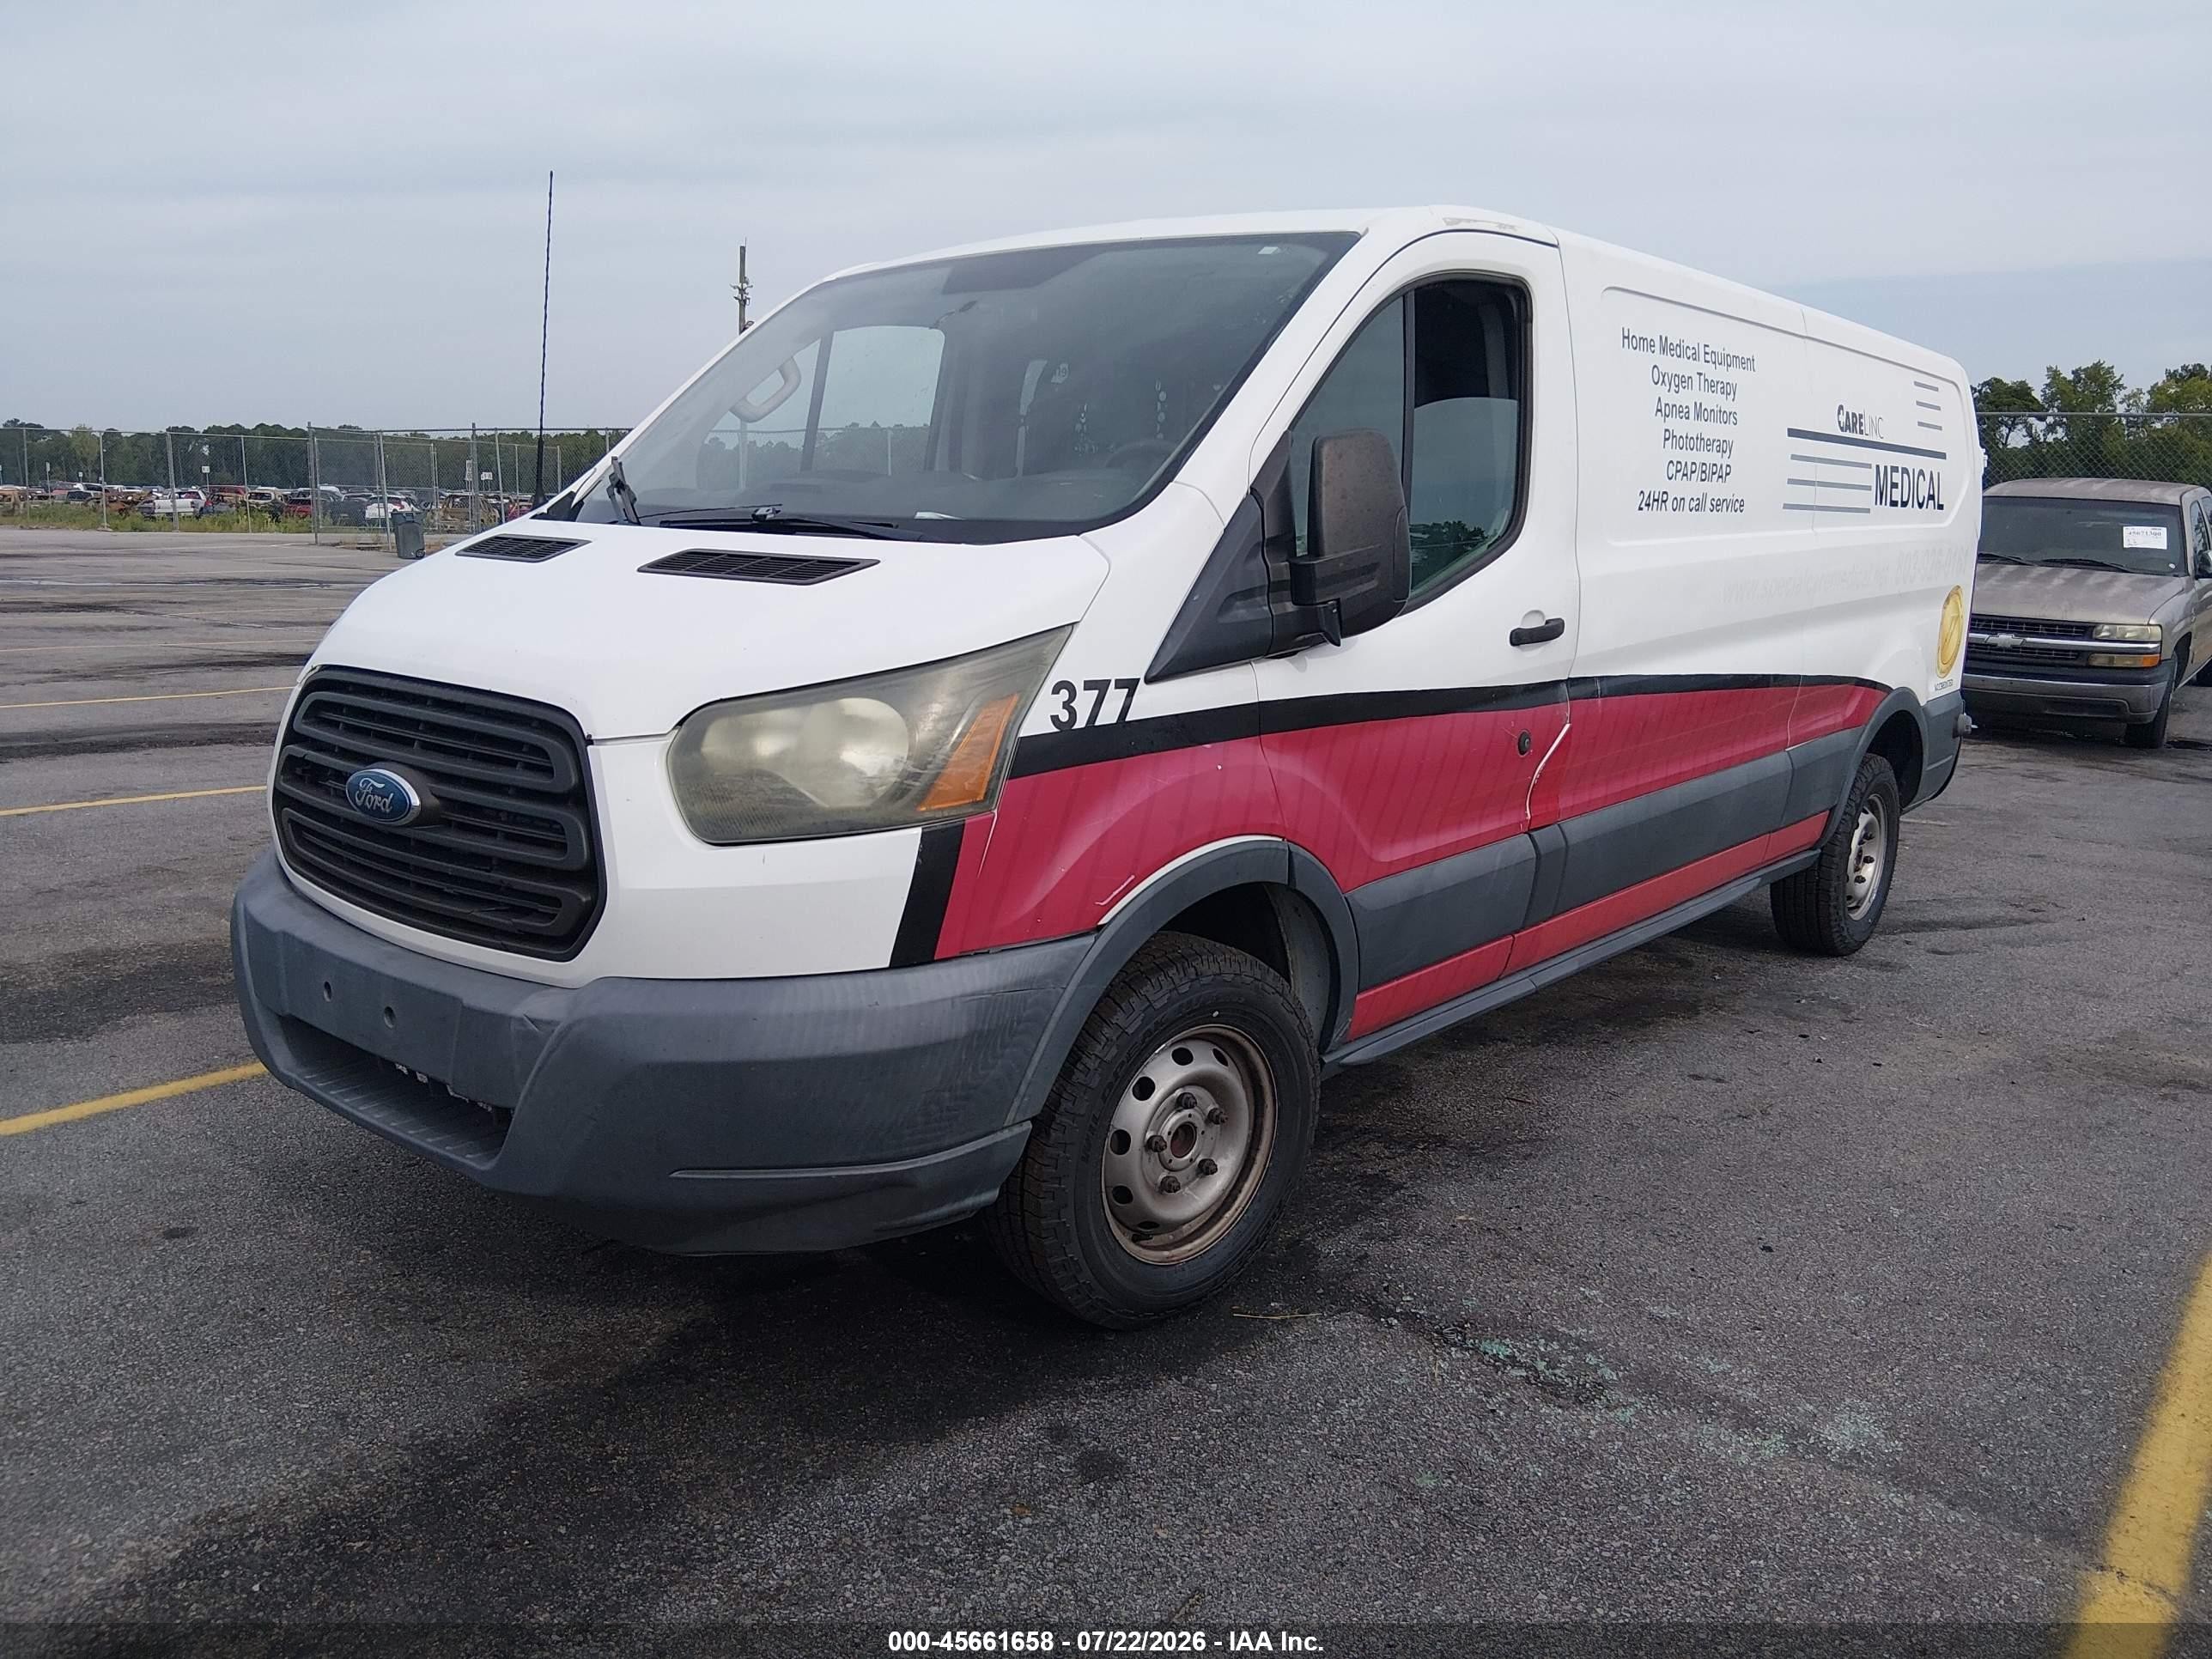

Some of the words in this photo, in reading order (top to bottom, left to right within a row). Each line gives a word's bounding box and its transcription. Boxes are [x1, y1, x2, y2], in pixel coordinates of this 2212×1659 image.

[1621, 326, 1656, 354] Home
[1659, 334, 1700, 362] Medical
[1703, 343, 1756, 373] Equipment
[1651, 364, 1693, 394] Oxygen
[1696, 371, 1738, 403] Therapy
[1655, 396, 1690, 423] Apnea
[1693, 401, 1738, 426] Monitors
[1662, 428, 1734, 459] Phototherapy
[1666, 459, 1732, 483] CPAP/BIPAP
[1875, 464, 1945, 511] MEDICAL
[1638, 489, 1669, 512] 24HR
[1671, 496, 1686, 513] on
[1688, 491, 1708, 513] call
[1709, 493, 1745, 514] service
[1049, 678, 1141, 731] 377
[355, 777, 394, 814] Ford
